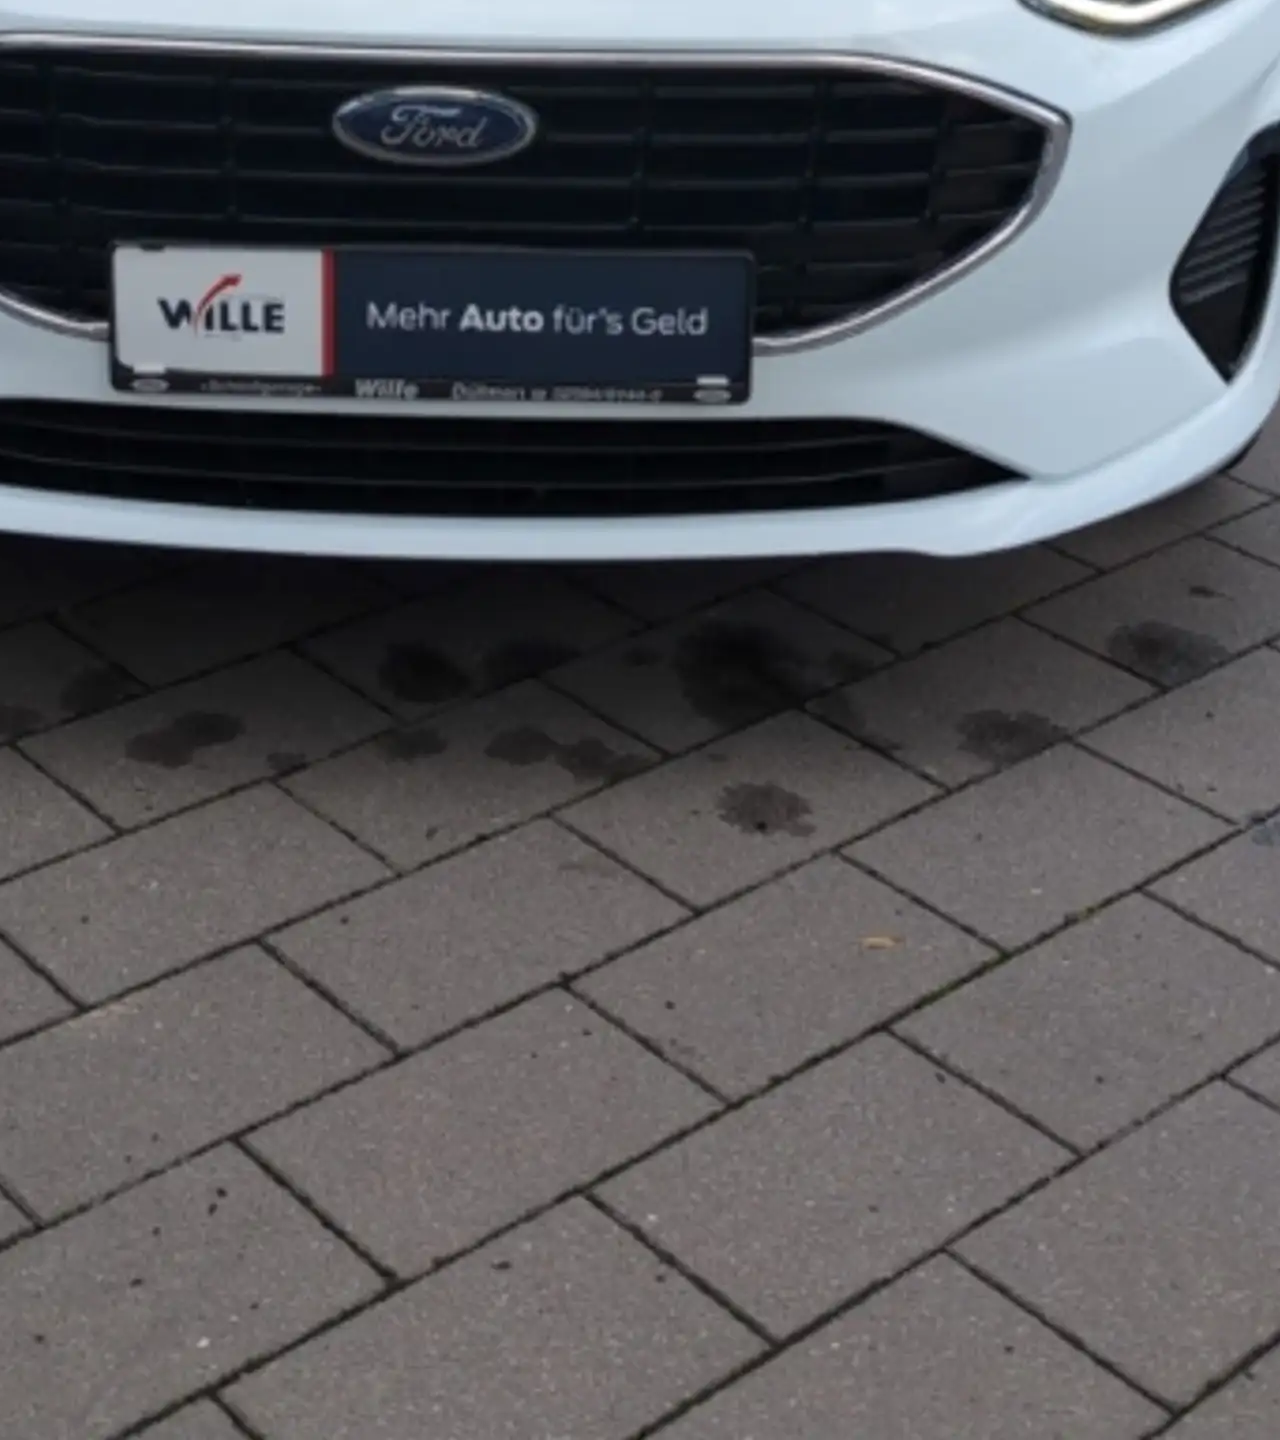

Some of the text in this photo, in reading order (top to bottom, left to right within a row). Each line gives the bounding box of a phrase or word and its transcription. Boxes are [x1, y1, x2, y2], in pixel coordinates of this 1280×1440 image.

[380, 104, 488, 148] Ford
[365, 300, 450, 331] Mehr
[458, 303, 545, 333] Auto
[630, 306, 708, 336] Geld
